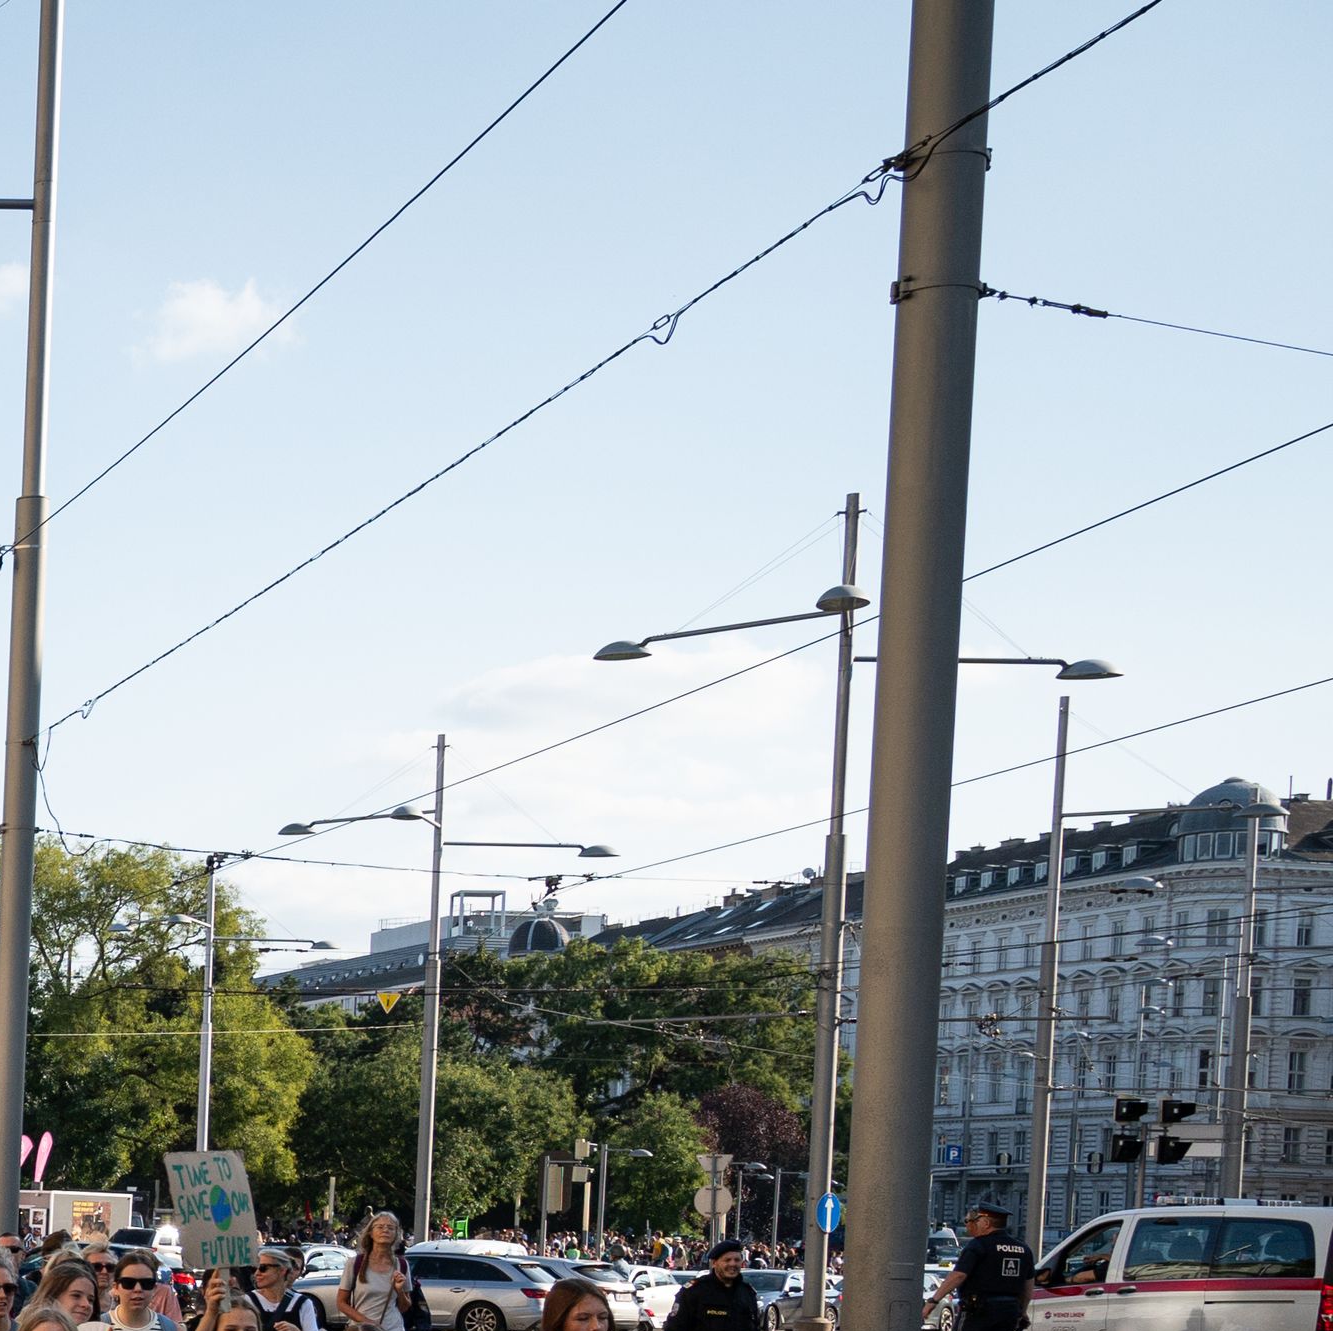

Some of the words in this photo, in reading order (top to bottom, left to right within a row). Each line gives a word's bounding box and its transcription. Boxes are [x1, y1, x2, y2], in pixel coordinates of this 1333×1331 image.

[949, 1149, 959, 1160] P
[171, 1161, 212, 1190] TIME
[212, 1156, 232, 1181] TO
[177, 1189, 212, 1226] SAVE
[230, 1190, 251, 1217] OUR
[200, 1235, 252, 1265] FUTURE
[996, 1244, 1025, 1254] POLIZEI
[1007, 1260, 1016, 1269] A
